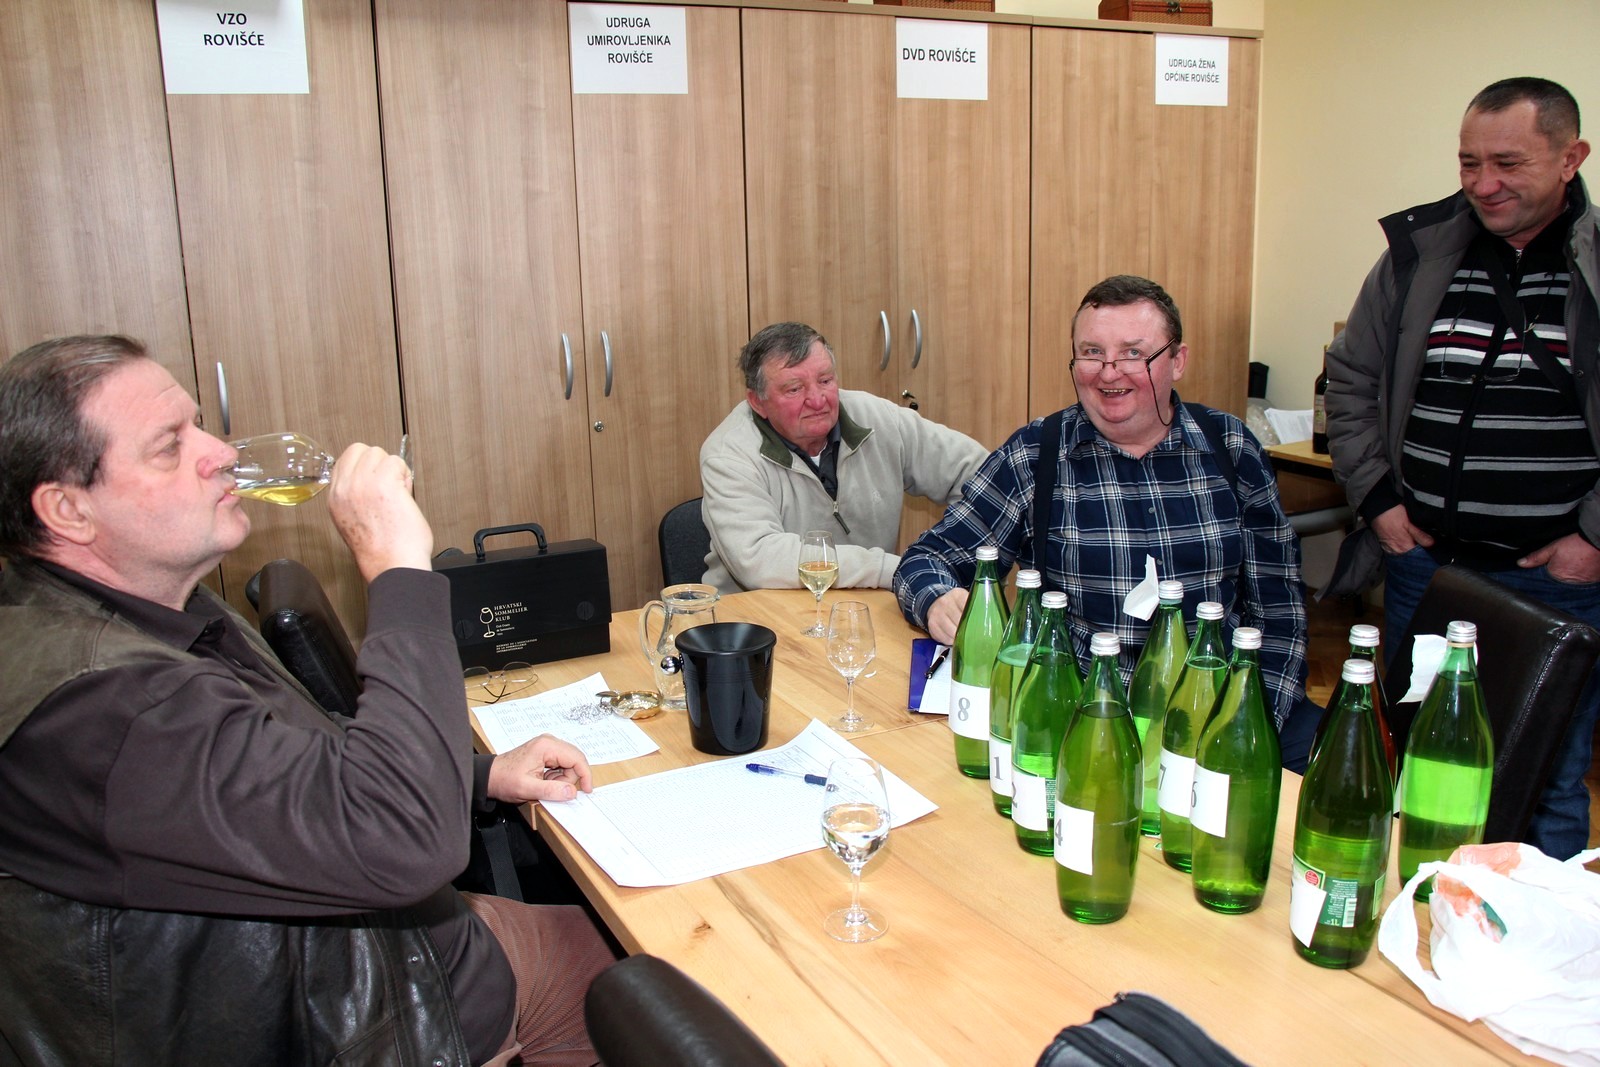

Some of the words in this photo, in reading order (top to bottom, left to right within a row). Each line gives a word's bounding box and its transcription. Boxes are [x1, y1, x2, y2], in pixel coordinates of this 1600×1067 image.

[216, 12, 247, 25] VZO
[606, 17, 651, 28] UDRUGA
[203, 31, 265, 46] ROVIŠĆE
[587, 35, 671, 46] UMIROVLJENIKA
[608, 50, 653, 64] ROVIŠĆE
[902, 47, 926, 61] DVD
[928, 47, 976, 63] ROVIŠĆE
[1168, 58, 1197, 68] UDRUGA
[1198, 58, 1216, 69] ŽENA
[1190, 72, 1220, 83] ROVIŠĆE
[494, 602, 523, 611] HRVATSKI
[494, 606, 529, 617] SOMMELIER
[957, 697, 971, 722] 8
[993, 755, 1004, 780] 1
[1055, 818, 1063, 847] 4
